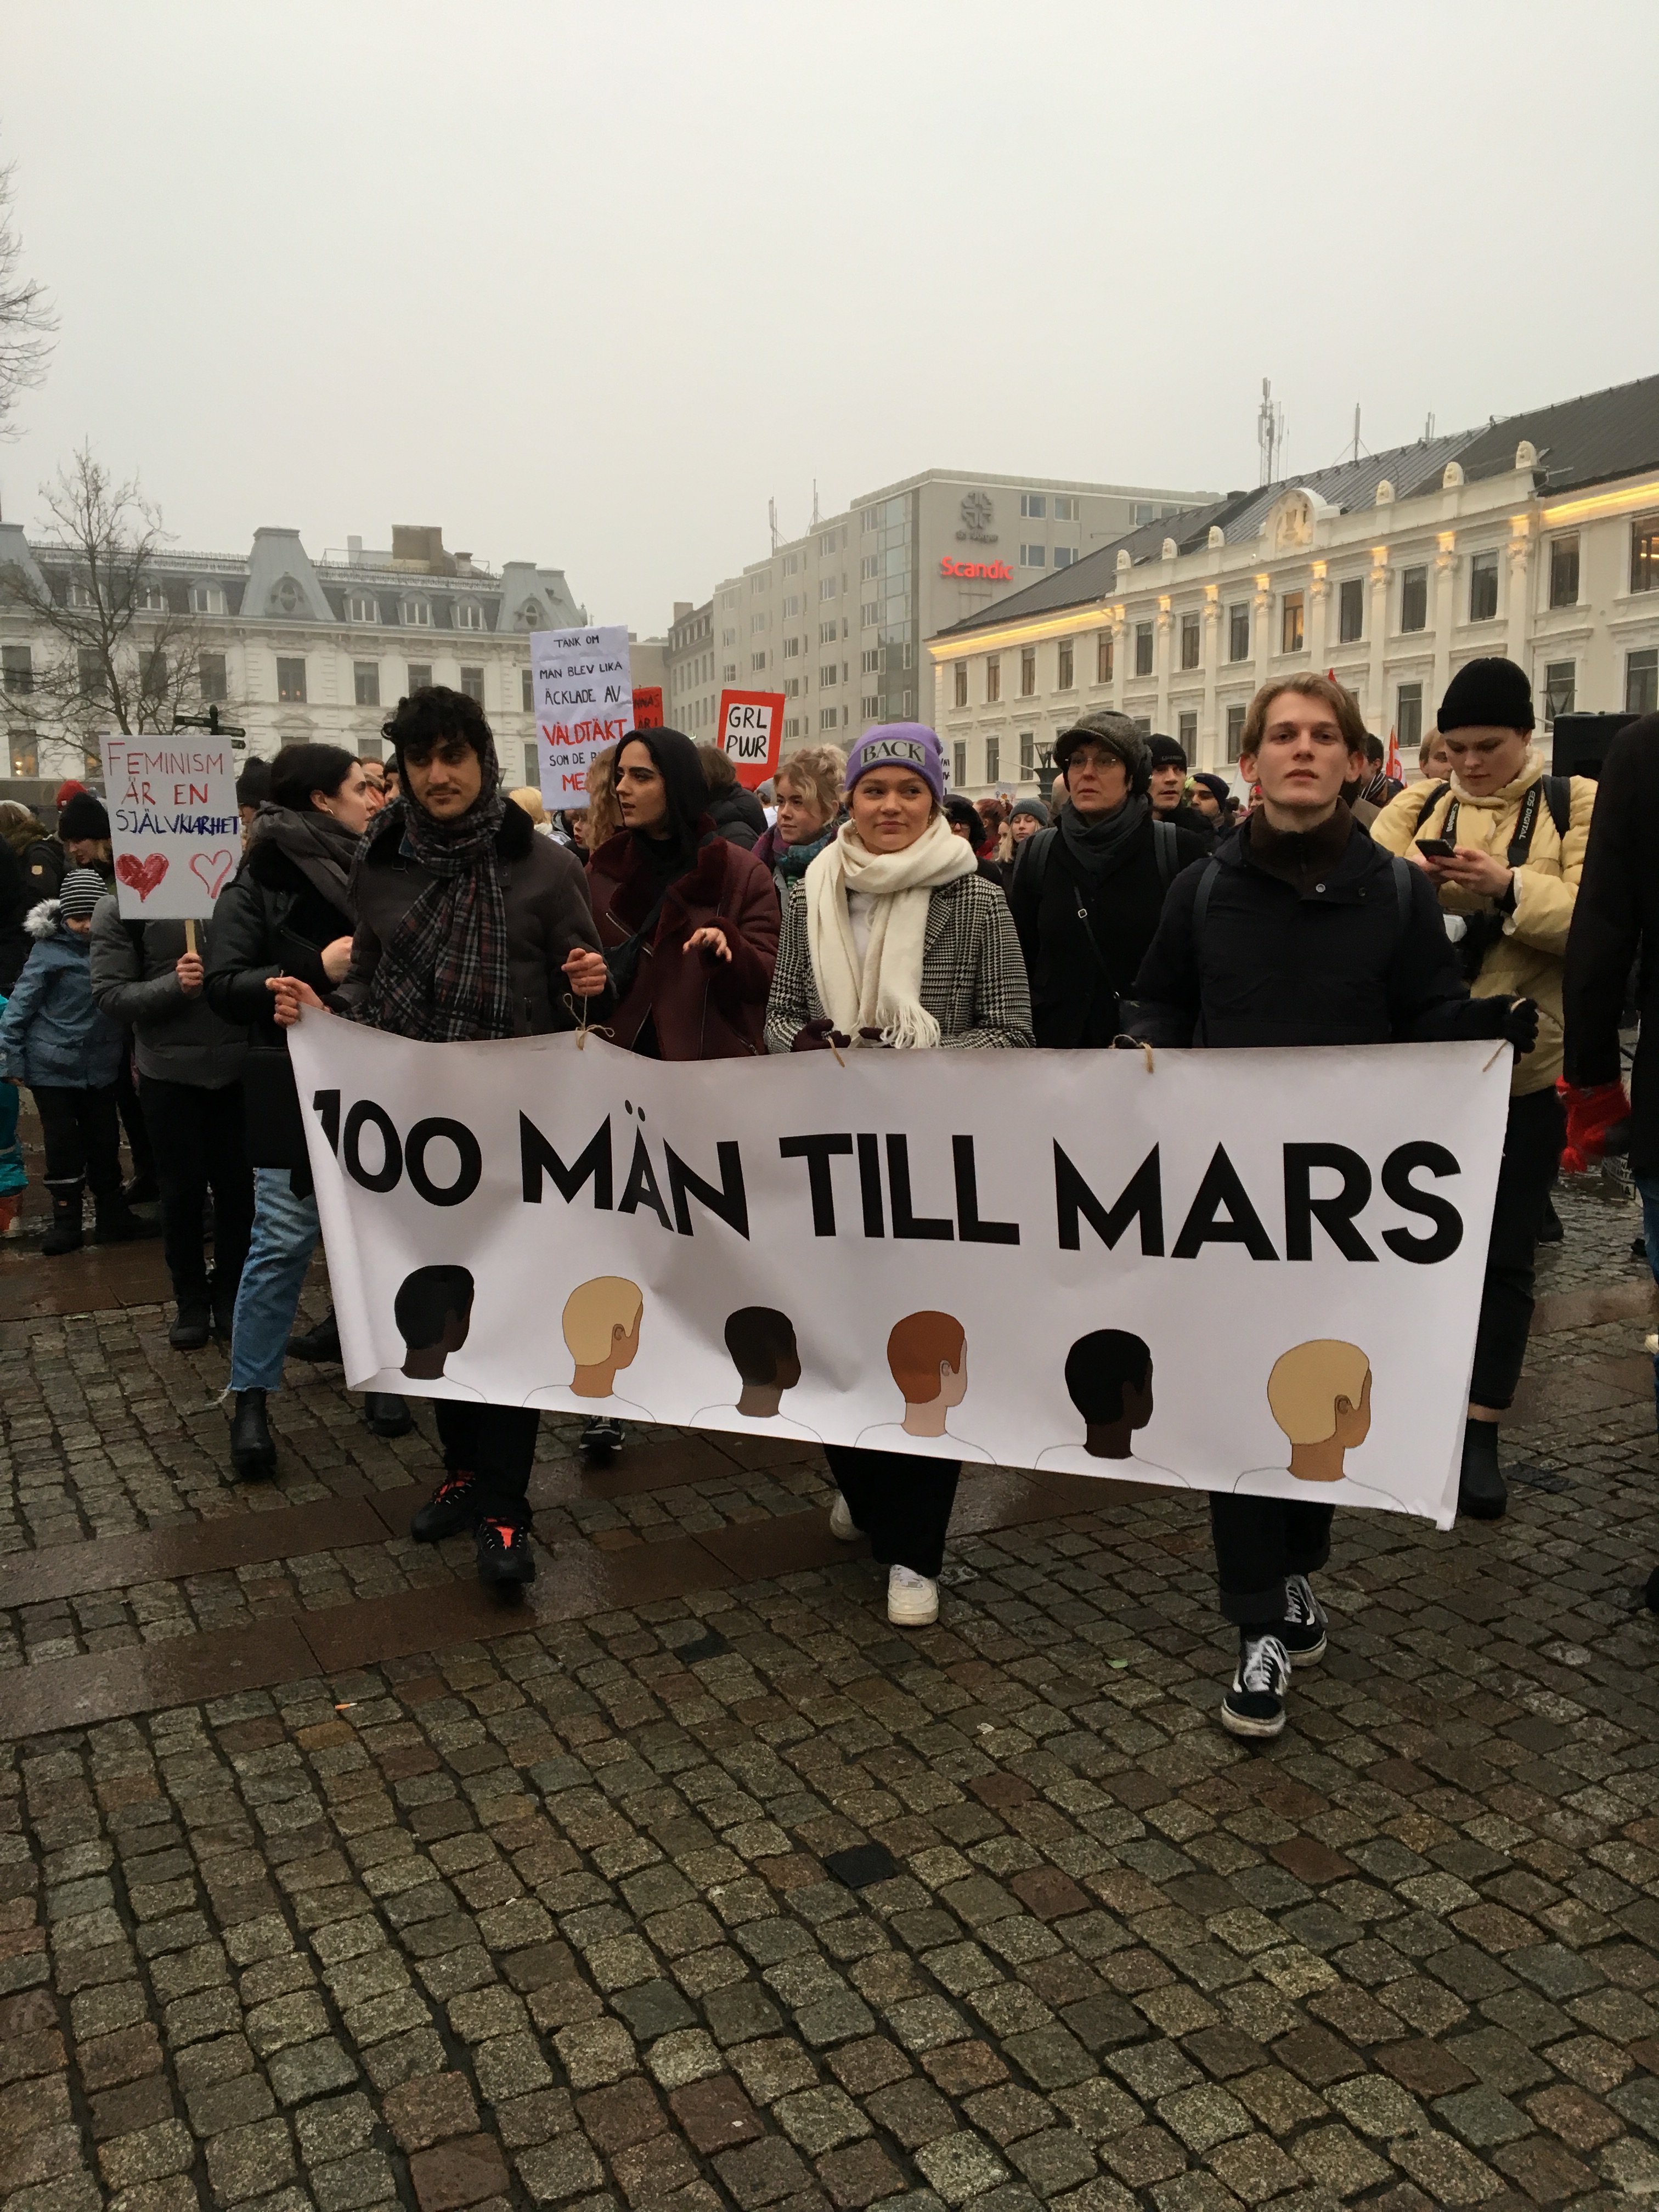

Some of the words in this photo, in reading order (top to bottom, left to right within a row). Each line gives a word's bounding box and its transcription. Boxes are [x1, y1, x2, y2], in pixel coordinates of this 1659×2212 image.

[941, 556, 1014, 580] Scandic
[553, 636, 582, 648] TÄNK
[586, 635, 600, 645] OM
[567, 664, 595, 677] BLEV
[599, 661, 623, 673] LIKA
[545, 687, 596, 706] ÄCKLADE
[604, 685, 622, 703] AV
[729, 706, 768, 729] GRL
[542, 718, 628, 746] VÅLDTÄKT
[726, 734, 767, 758] PWR
[863, 741, 922, 764] BACK
[107, 742, 223, 776] FEMINISM
[549, 754, 569, 767] SOM
[572, 752, 585, 765] DE
[121, 776, 156, 805] ÄR
[174, 783, 208, 805] EN
[562, 772, 589, 792] ME
[1527, 790, 1536, 808] EOS
[1519, 807, 1532, 840] DIGITAL
[313, 1089, 483, 1207] 100
[519, 1099, 751, 1242] MÄN
[778, 1132, 1021, 1246] TILL
[1052, 1136, 1465, 1265] MARS
